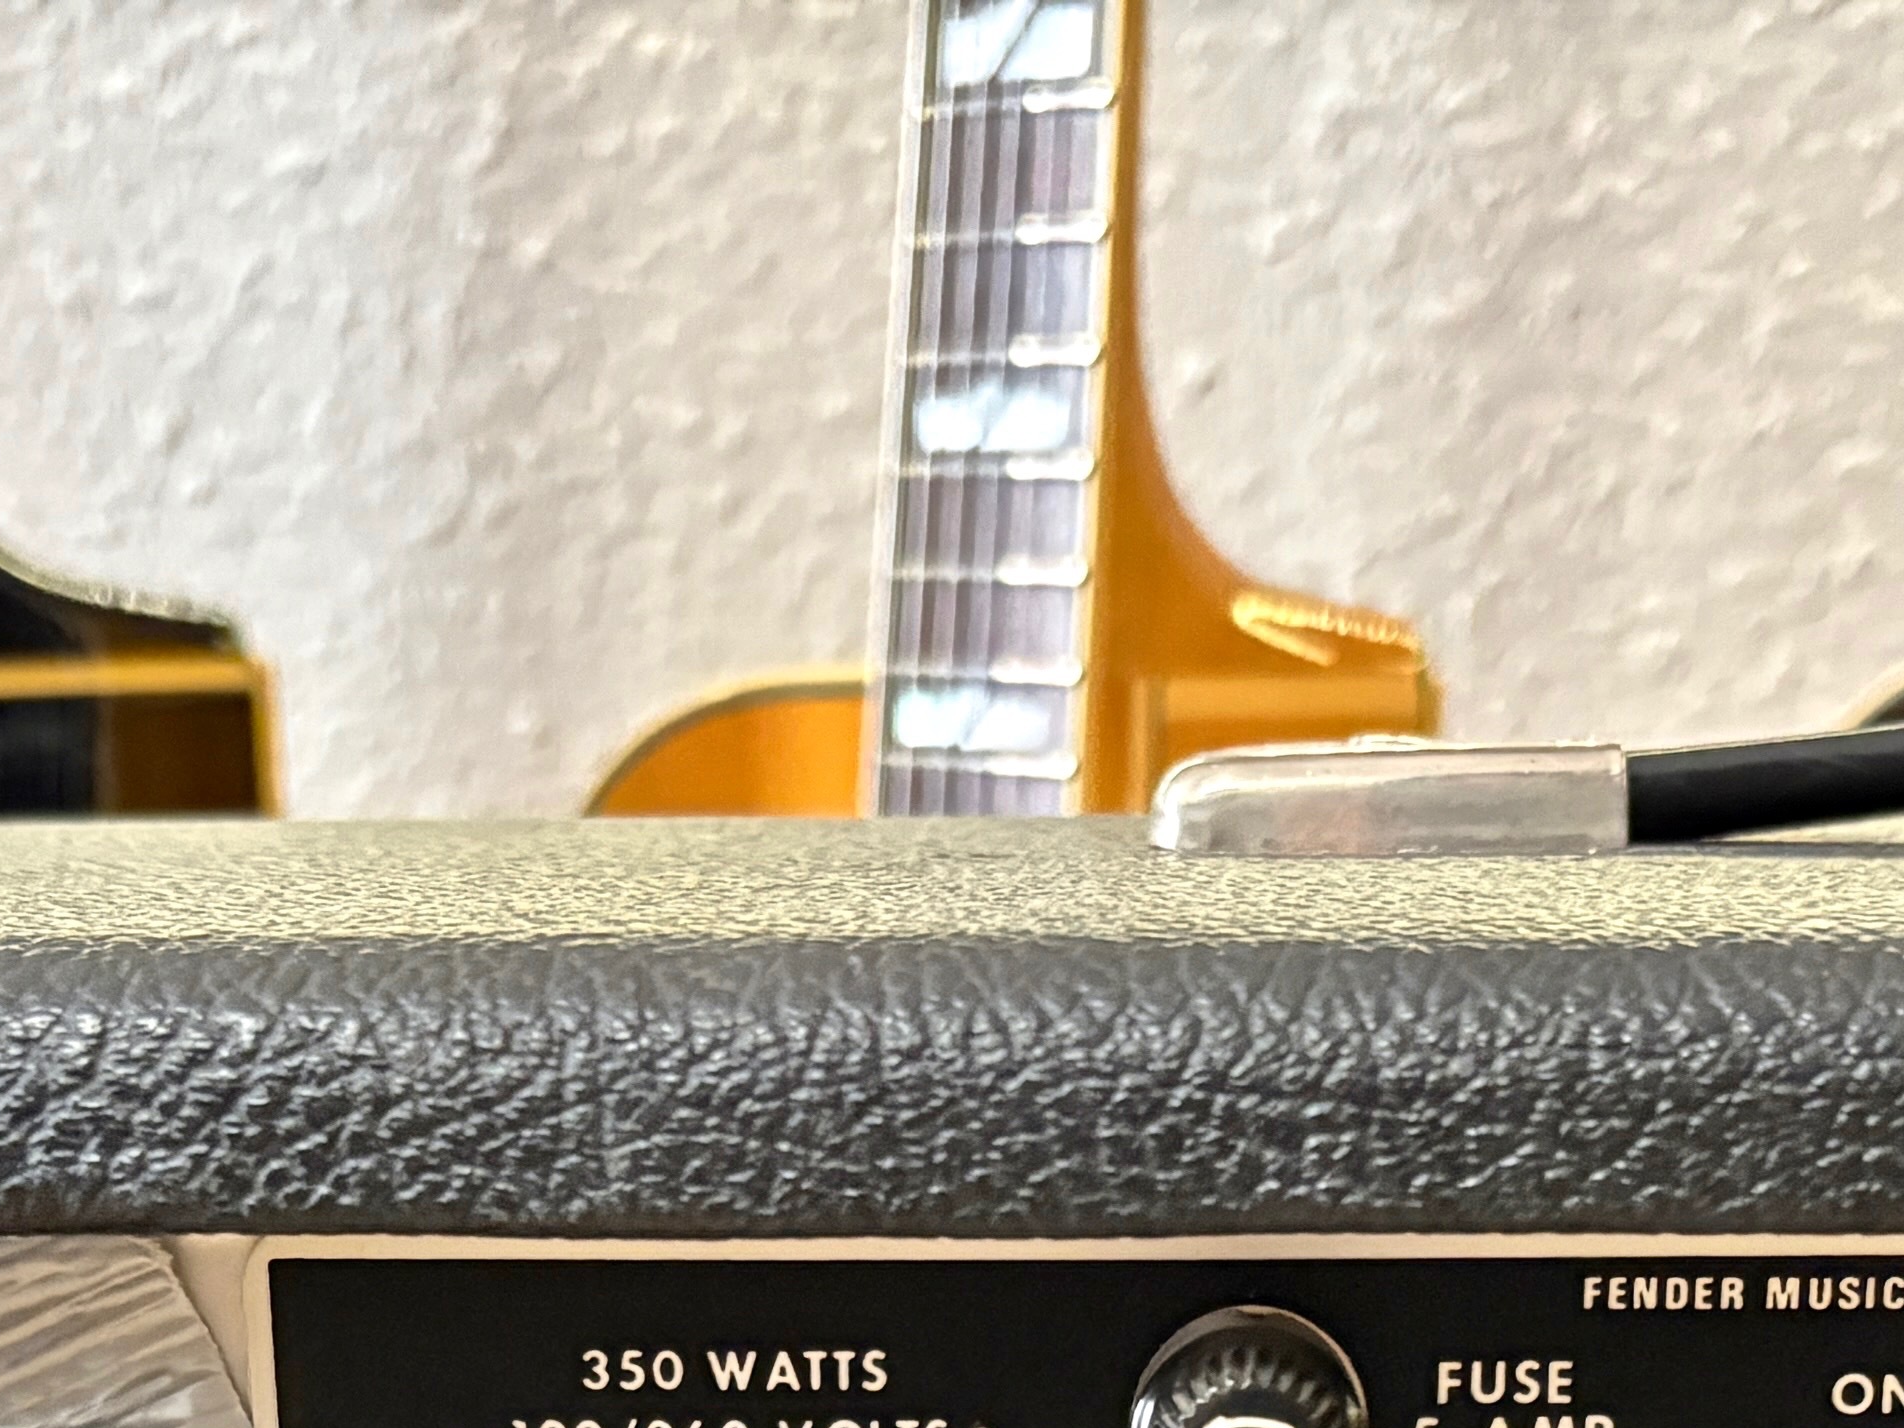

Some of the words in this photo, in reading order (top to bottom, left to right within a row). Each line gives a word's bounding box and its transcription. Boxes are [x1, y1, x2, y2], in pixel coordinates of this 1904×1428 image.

[1583, 1276, 1745, 1311] FENDER
[581, 1348, 686, 1392] 350
[705, 1348, 889, 1393] WATTS
[1436, 1358, 1574, 1405] FUSE
